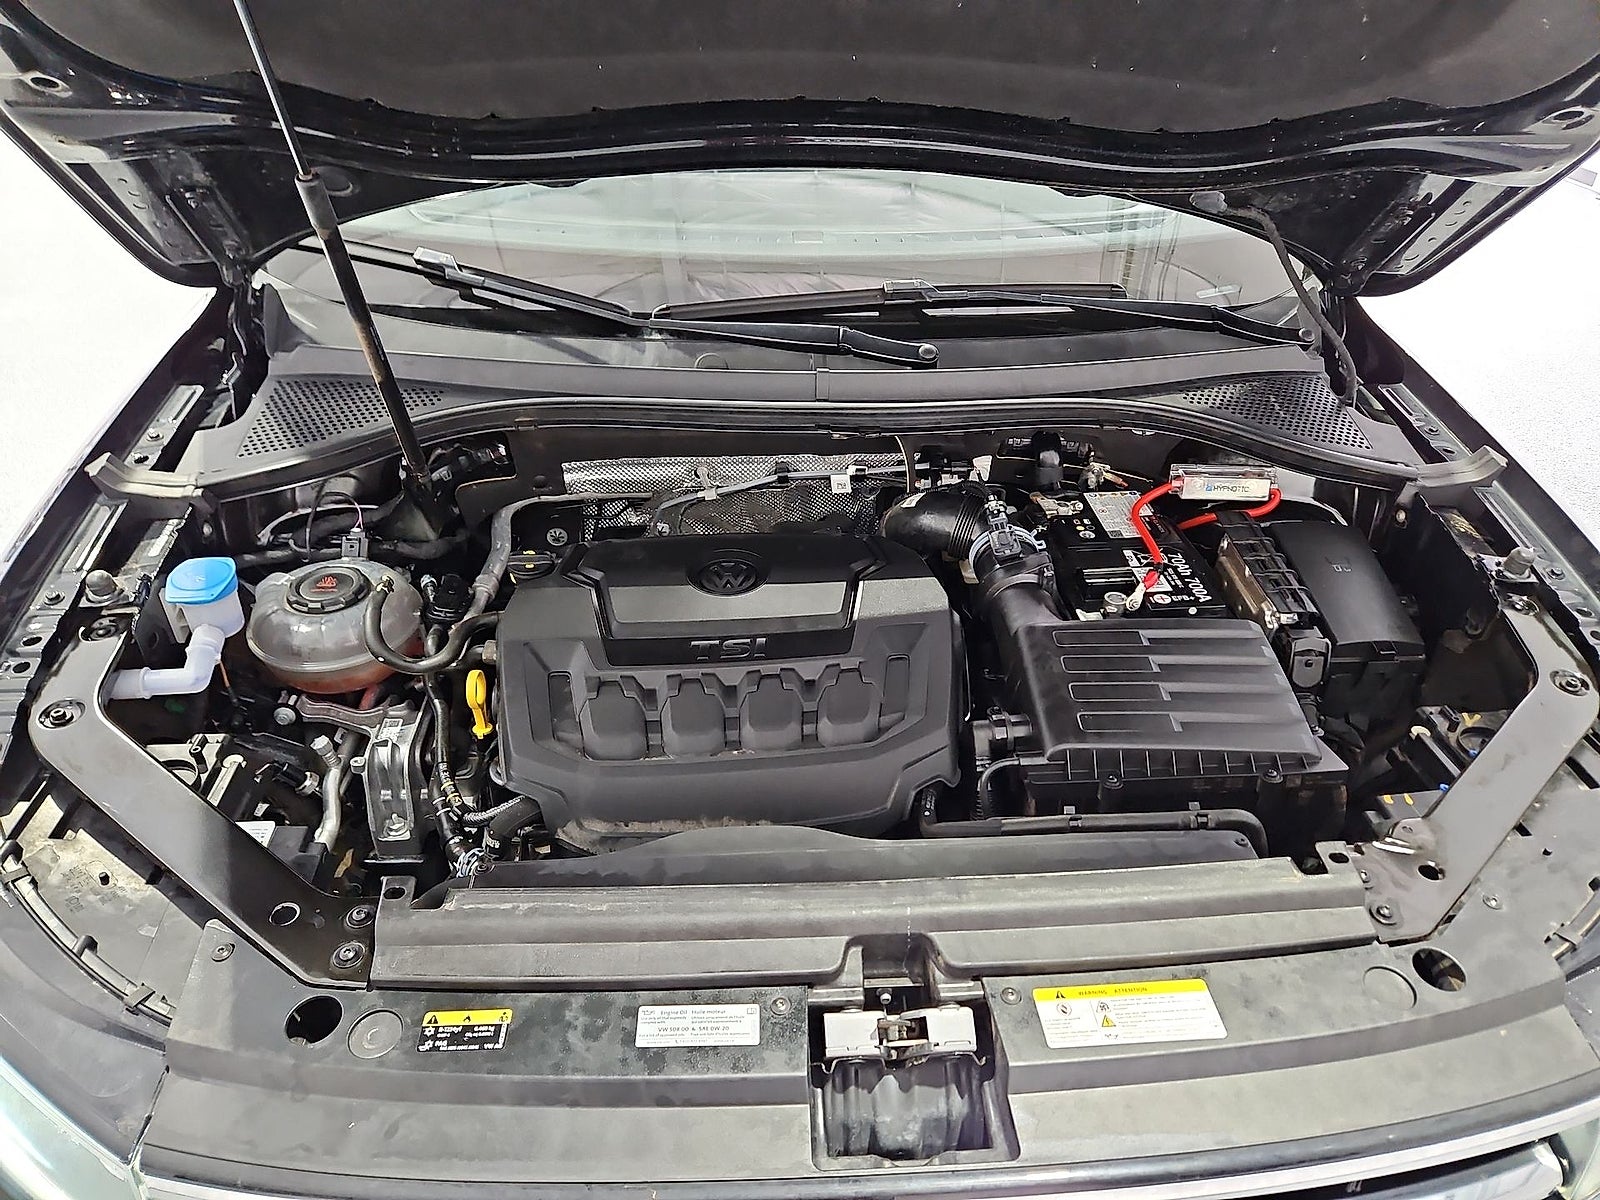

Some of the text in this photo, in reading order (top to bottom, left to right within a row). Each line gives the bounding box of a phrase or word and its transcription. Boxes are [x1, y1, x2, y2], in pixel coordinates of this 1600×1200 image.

[1167, 552, 1192, 576] 70Ah
[1184, 577, 1212, 602] 700A
[689, 638, 767, 660] TSI
